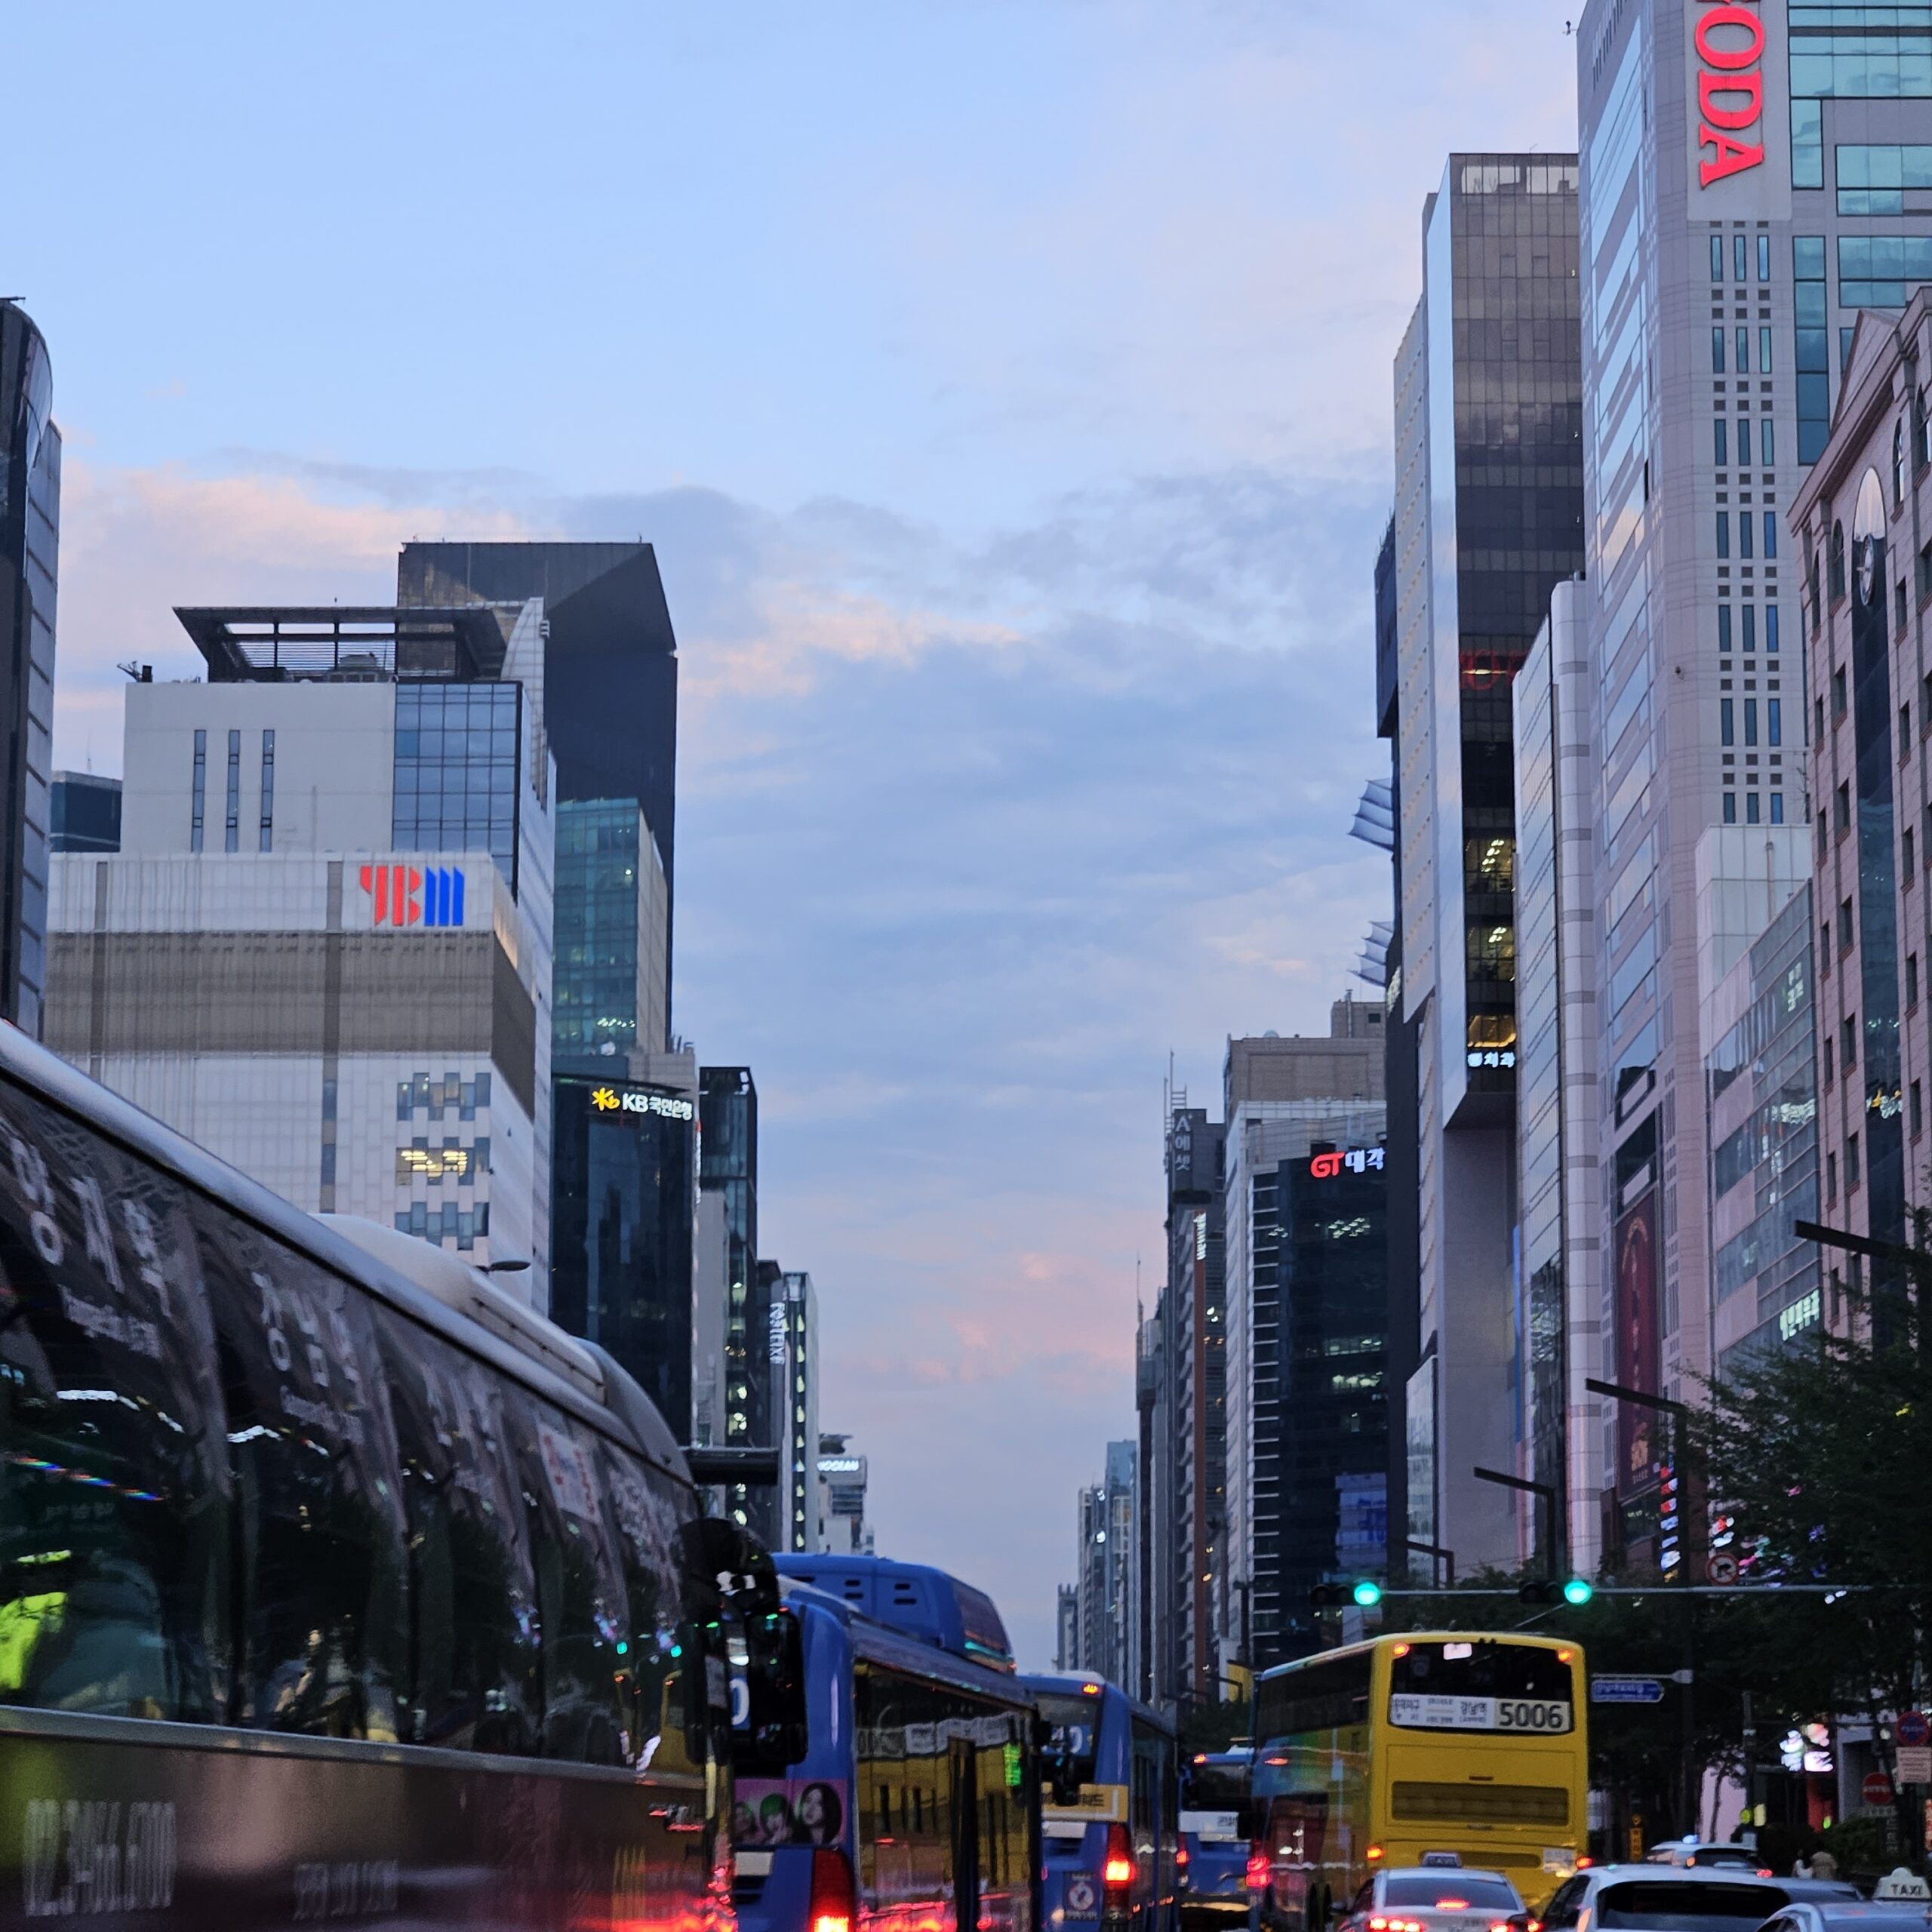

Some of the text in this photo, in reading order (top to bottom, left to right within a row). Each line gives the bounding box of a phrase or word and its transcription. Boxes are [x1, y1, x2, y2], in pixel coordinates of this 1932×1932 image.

[1695, 0, 1765, 190] ODA
[359, 865, 465, 927] YBM
[1499, 1703, 1564, 1729] 5006
[1890, 1884, 1923, 1896] TAXI
